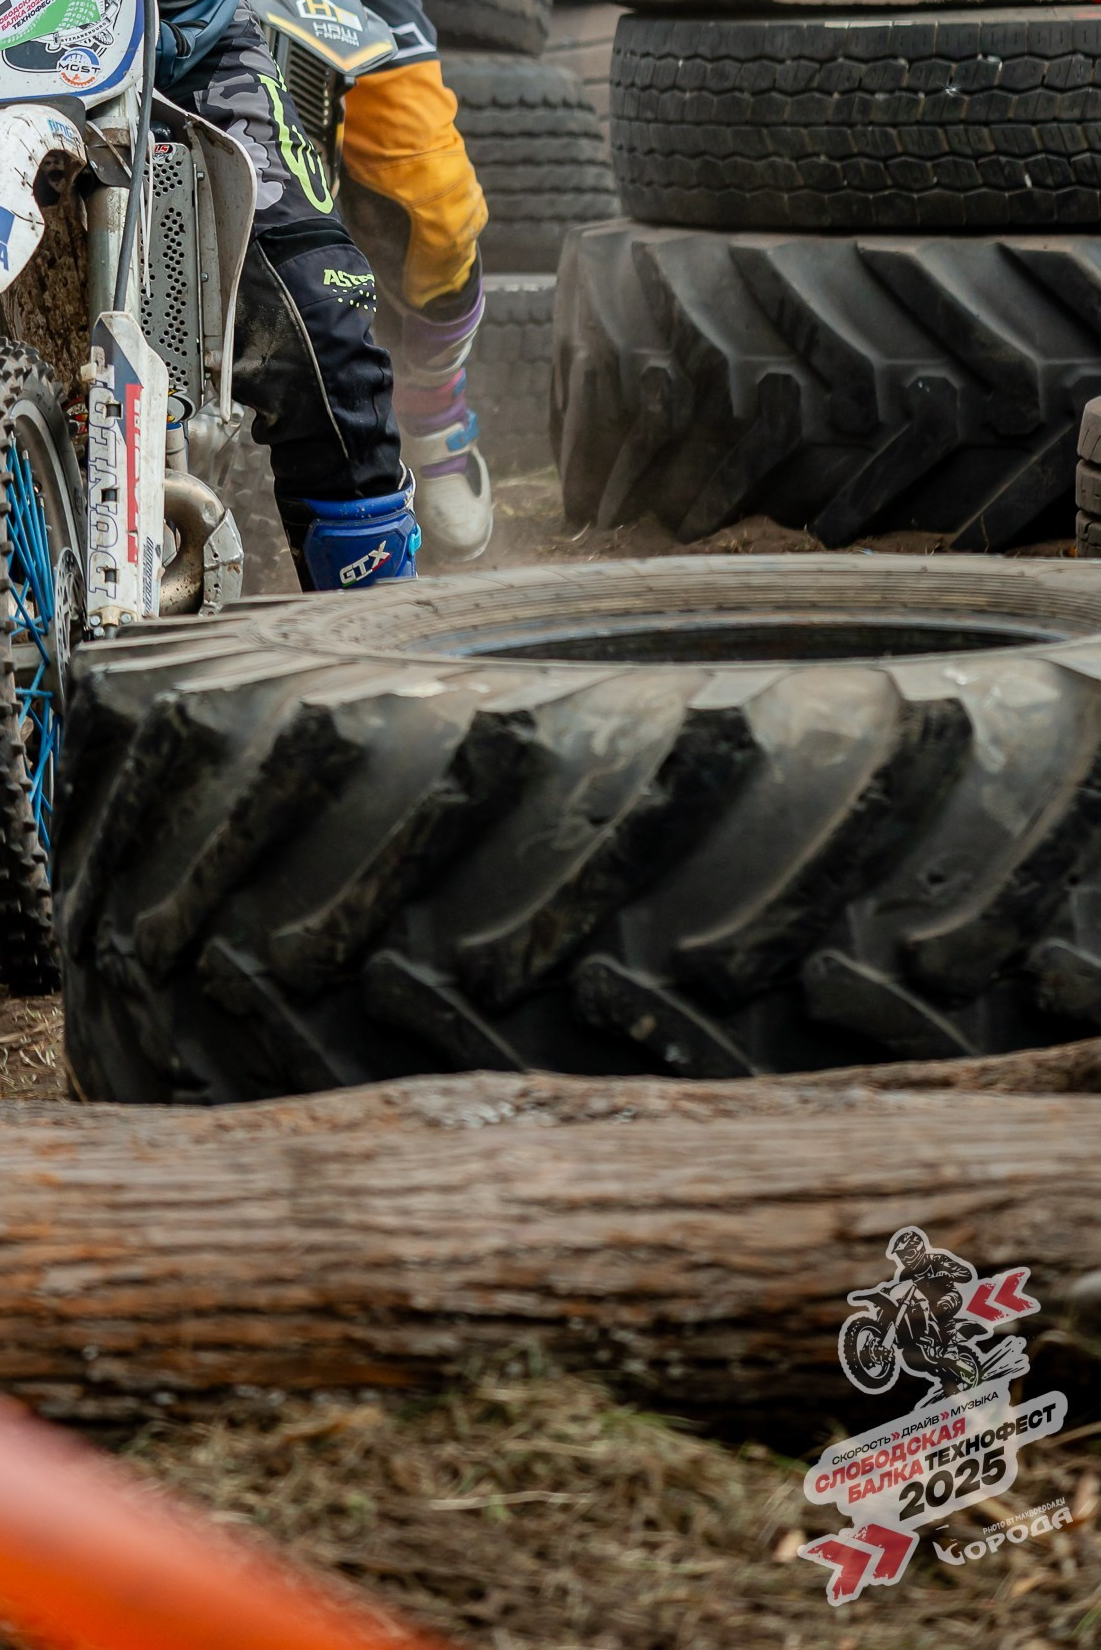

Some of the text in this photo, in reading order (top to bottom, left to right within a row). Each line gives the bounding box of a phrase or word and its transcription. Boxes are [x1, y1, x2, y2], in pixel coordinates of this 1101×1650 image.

[1, 9, 27, 32] БАЛКА
[58, 62, 101, 74] MOST
[87, 345, 118, 601] DUNLOP
[339, 540, 391, 586] GTX
